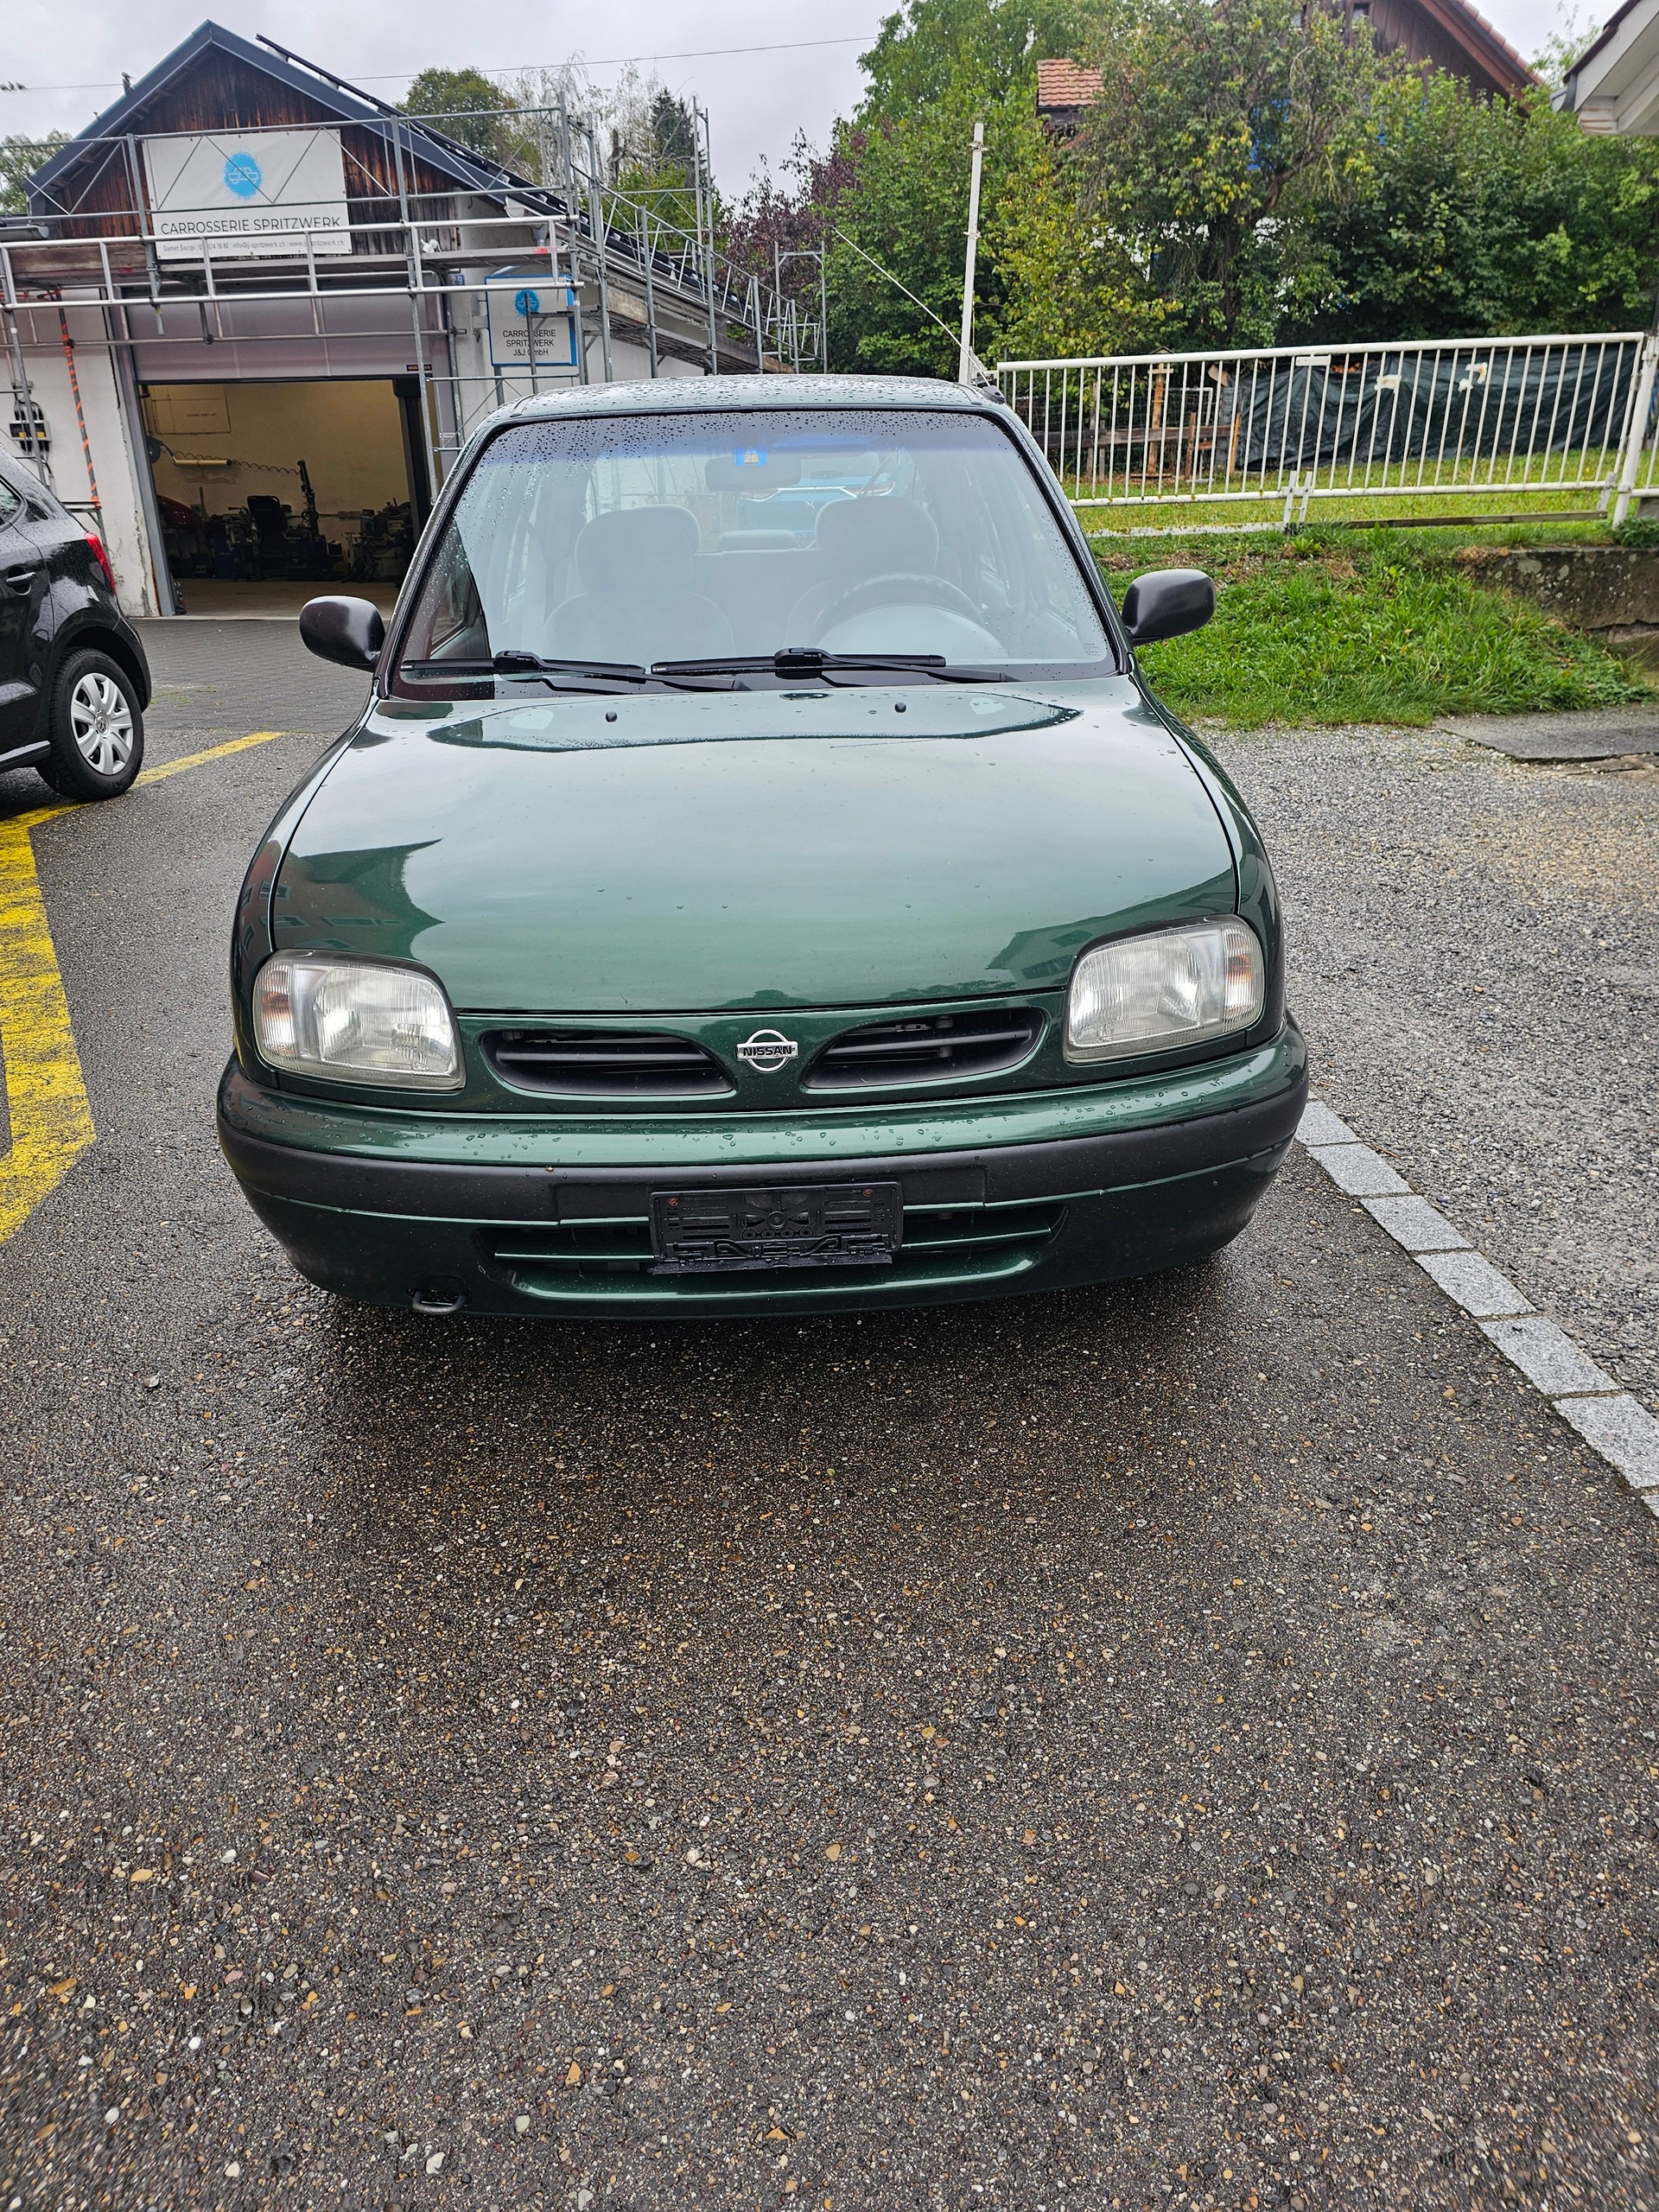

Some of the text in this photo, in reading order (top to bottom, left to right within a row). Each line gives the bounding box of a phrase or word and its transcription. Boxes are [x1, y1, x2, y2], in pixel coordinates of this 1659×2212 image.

[161, 217, 340, 235] CARROSSERIE SPRITZWERK
[451, 275, 463, 285] 29
[502, 329, 556, 338] CARROSERIE
[744, 454, 758, 463] 26
[743, 1045, 792, 1057] NISSAN
